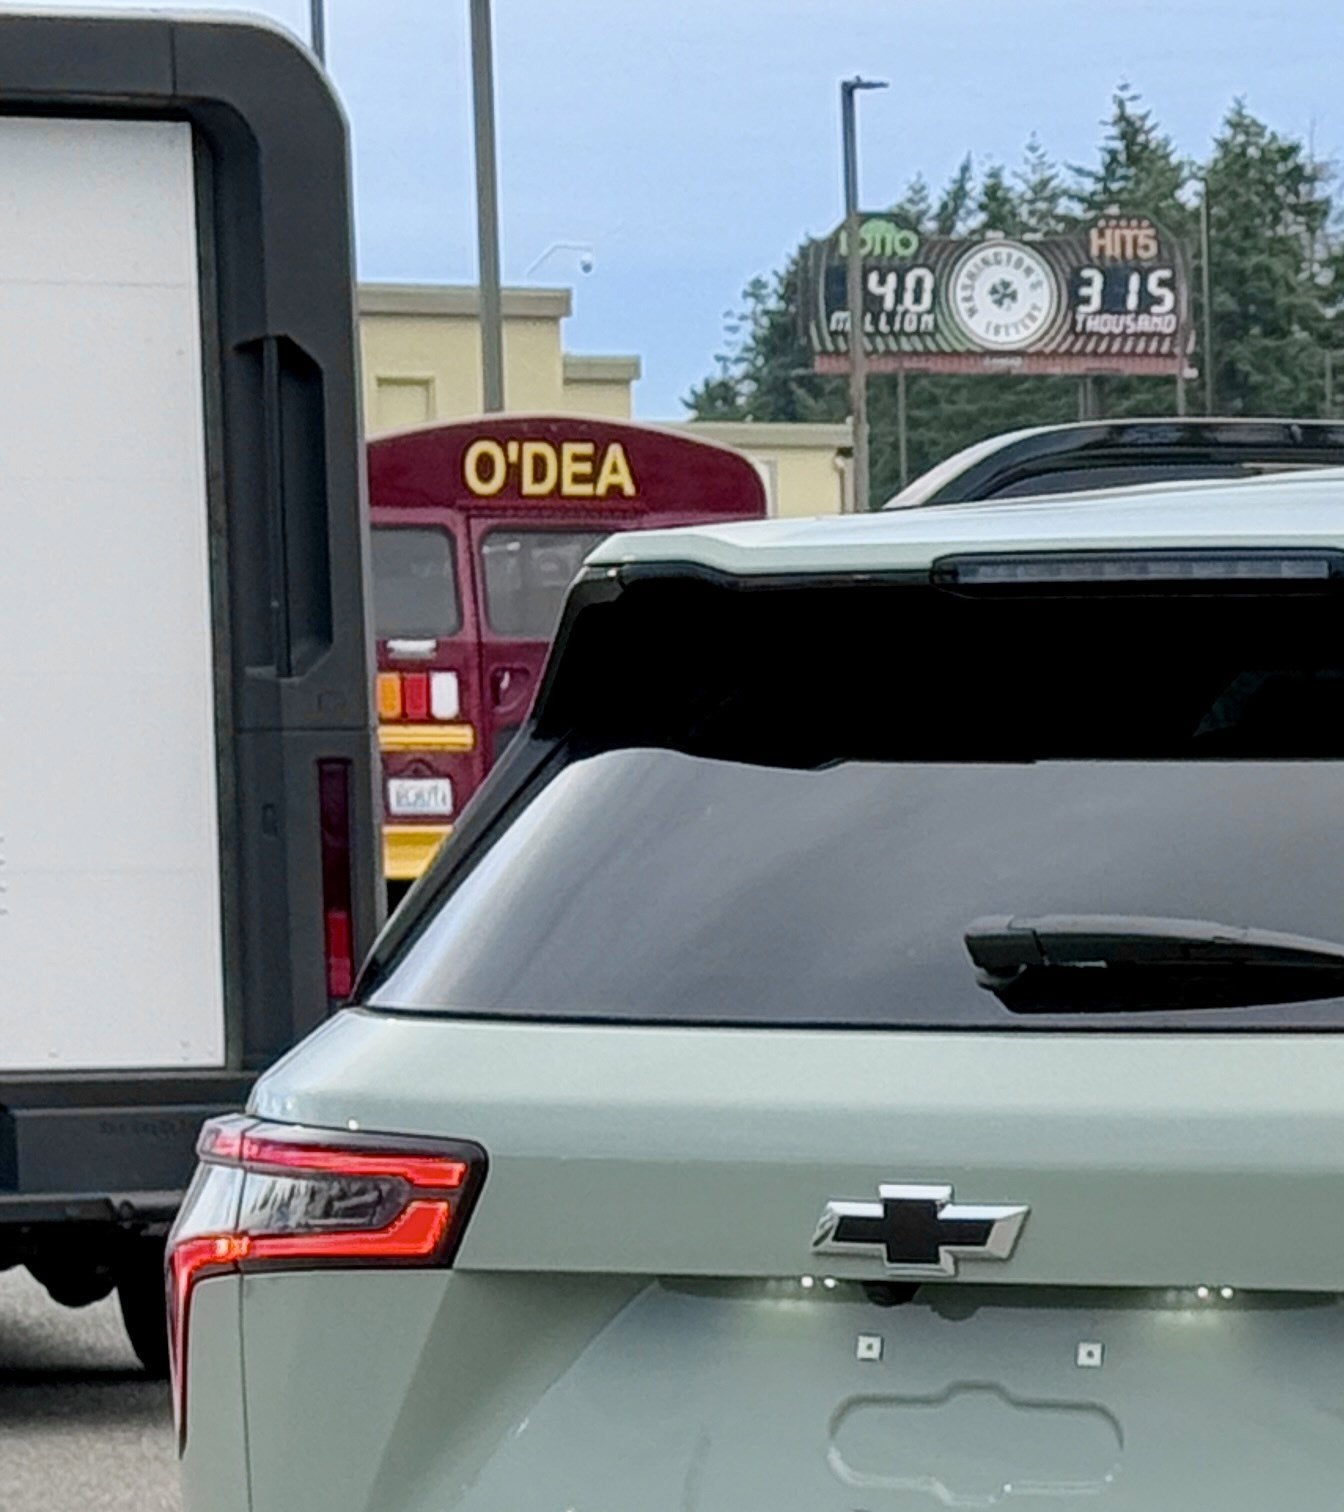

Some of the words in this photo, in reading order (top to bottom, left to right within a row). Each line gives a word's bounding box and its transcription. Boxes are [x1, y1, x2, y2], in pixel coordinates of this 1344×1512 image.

[867, 267, 935, 312] 40
[829, 305, 936, 334] MLLION
[1075, 313, 1177, 334] THOUSAND
[464, 438, 637, 497] O'DEA
